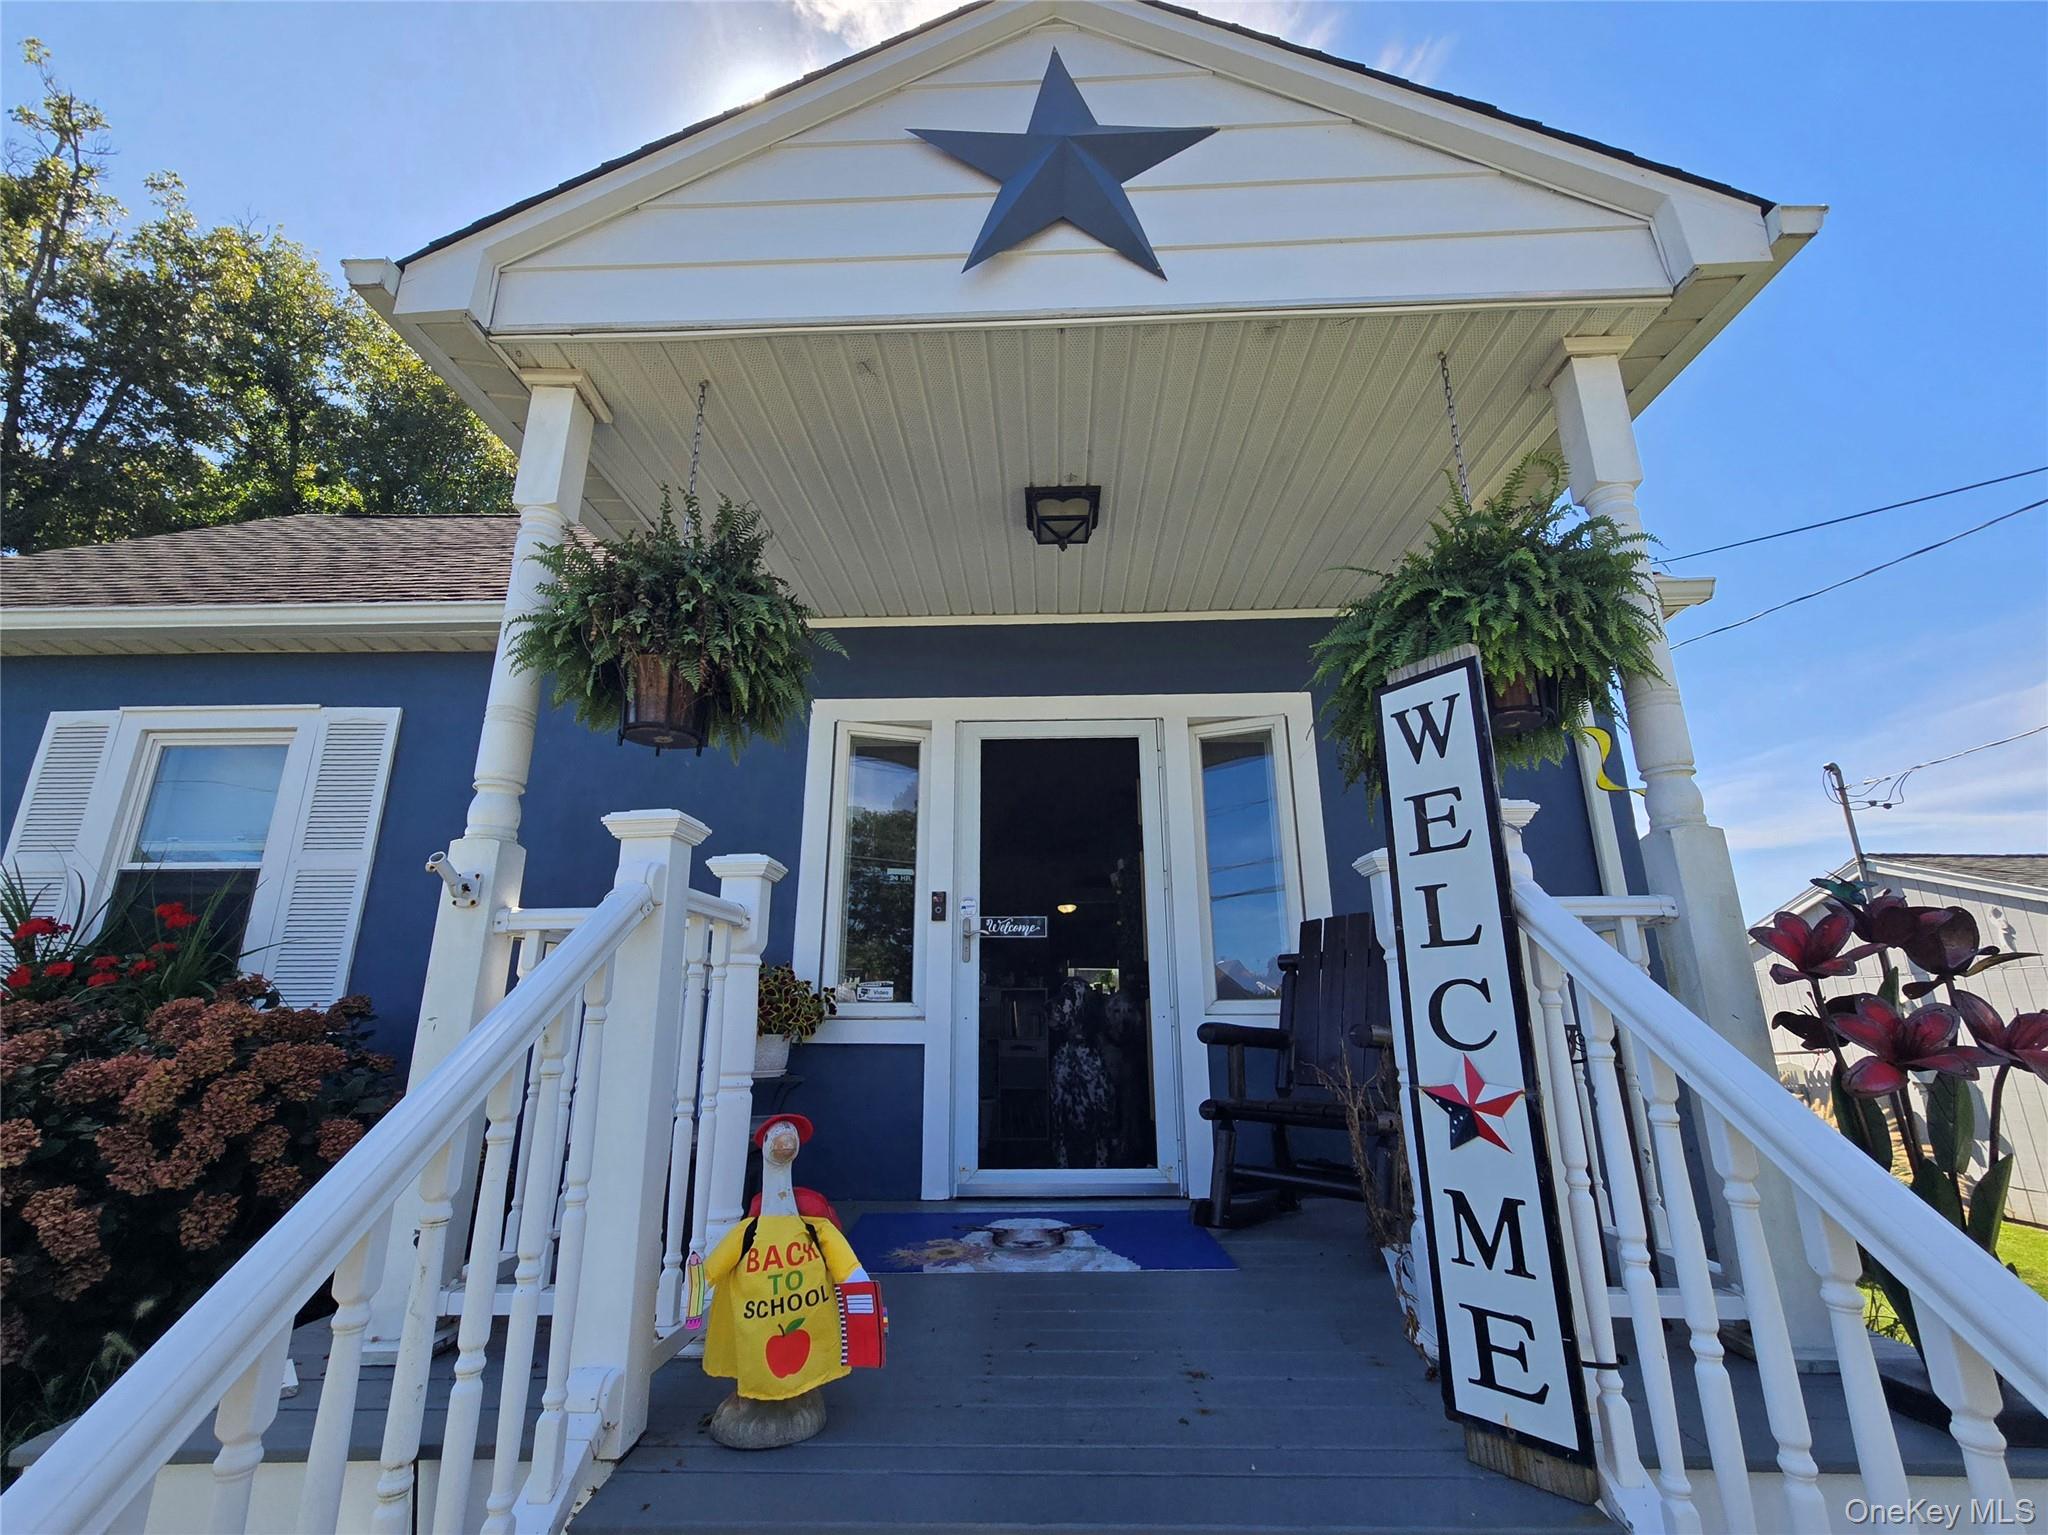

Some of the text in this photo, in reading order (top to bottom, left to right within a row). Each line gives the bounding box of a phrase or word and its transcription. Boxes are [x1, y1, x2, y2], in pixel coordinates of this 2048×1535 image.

[986, 917, 1041, 936] Welcome
[746, 1241, 820, 1273] BACK
[767, 1270, 804, 1296] TO
[743, 1285, 830, 1319] SCHOOL
